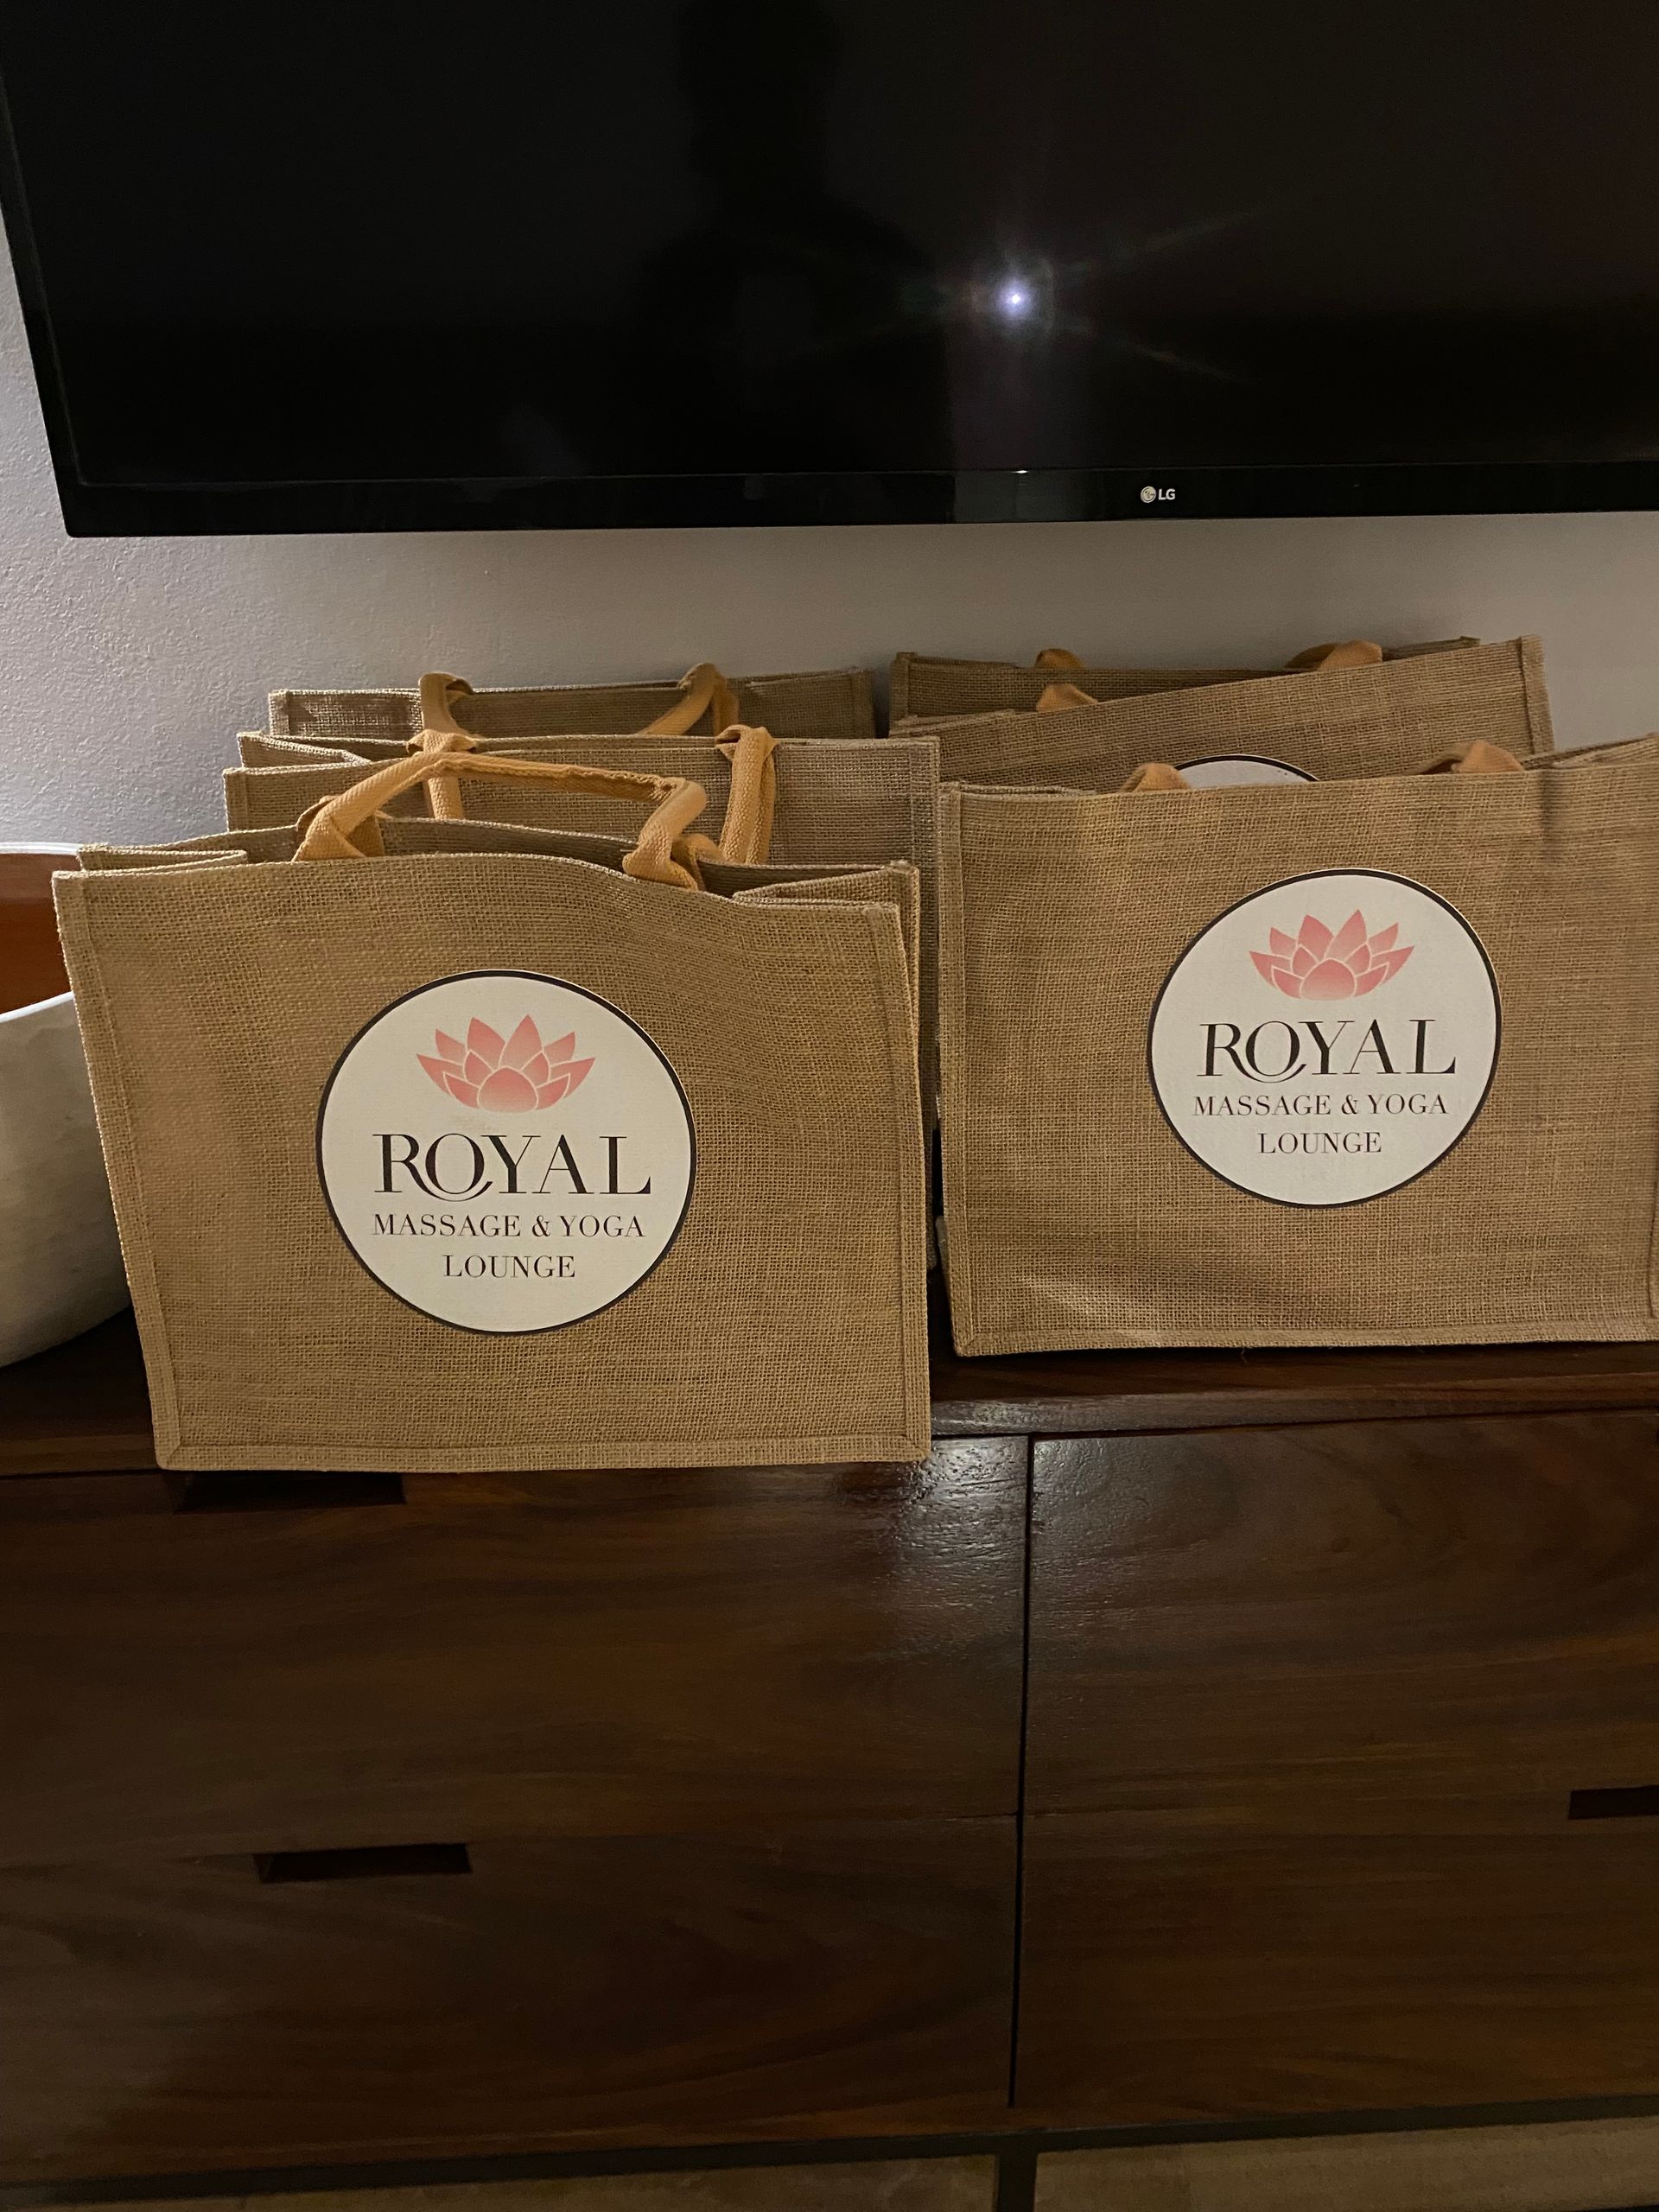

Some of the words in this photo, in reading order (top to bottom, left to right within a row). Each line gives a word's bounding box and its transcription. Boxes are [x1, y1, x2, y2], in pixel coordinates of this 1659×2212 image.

[1158, 488, 1176, 500] LG
[1196, 1018, 1457, 1084] ROYAL
[1194, 1095, 1332, 1116] MASSAGE
[1341, 1094, 1360, 1116] &
[1366, 1094, 1449, 1115] YOGA
[1258, 1132, 1382, 1155] LOUNGE
[371, 1133, 652, 1203] ROYAL
[372, 1213, 521, 1237] MASSAGE
[531, 1215, 552, 1237] &
[557, 1215, 645, 1238] YOGA
[442, 1255, 577, 1279] LOUNGE
